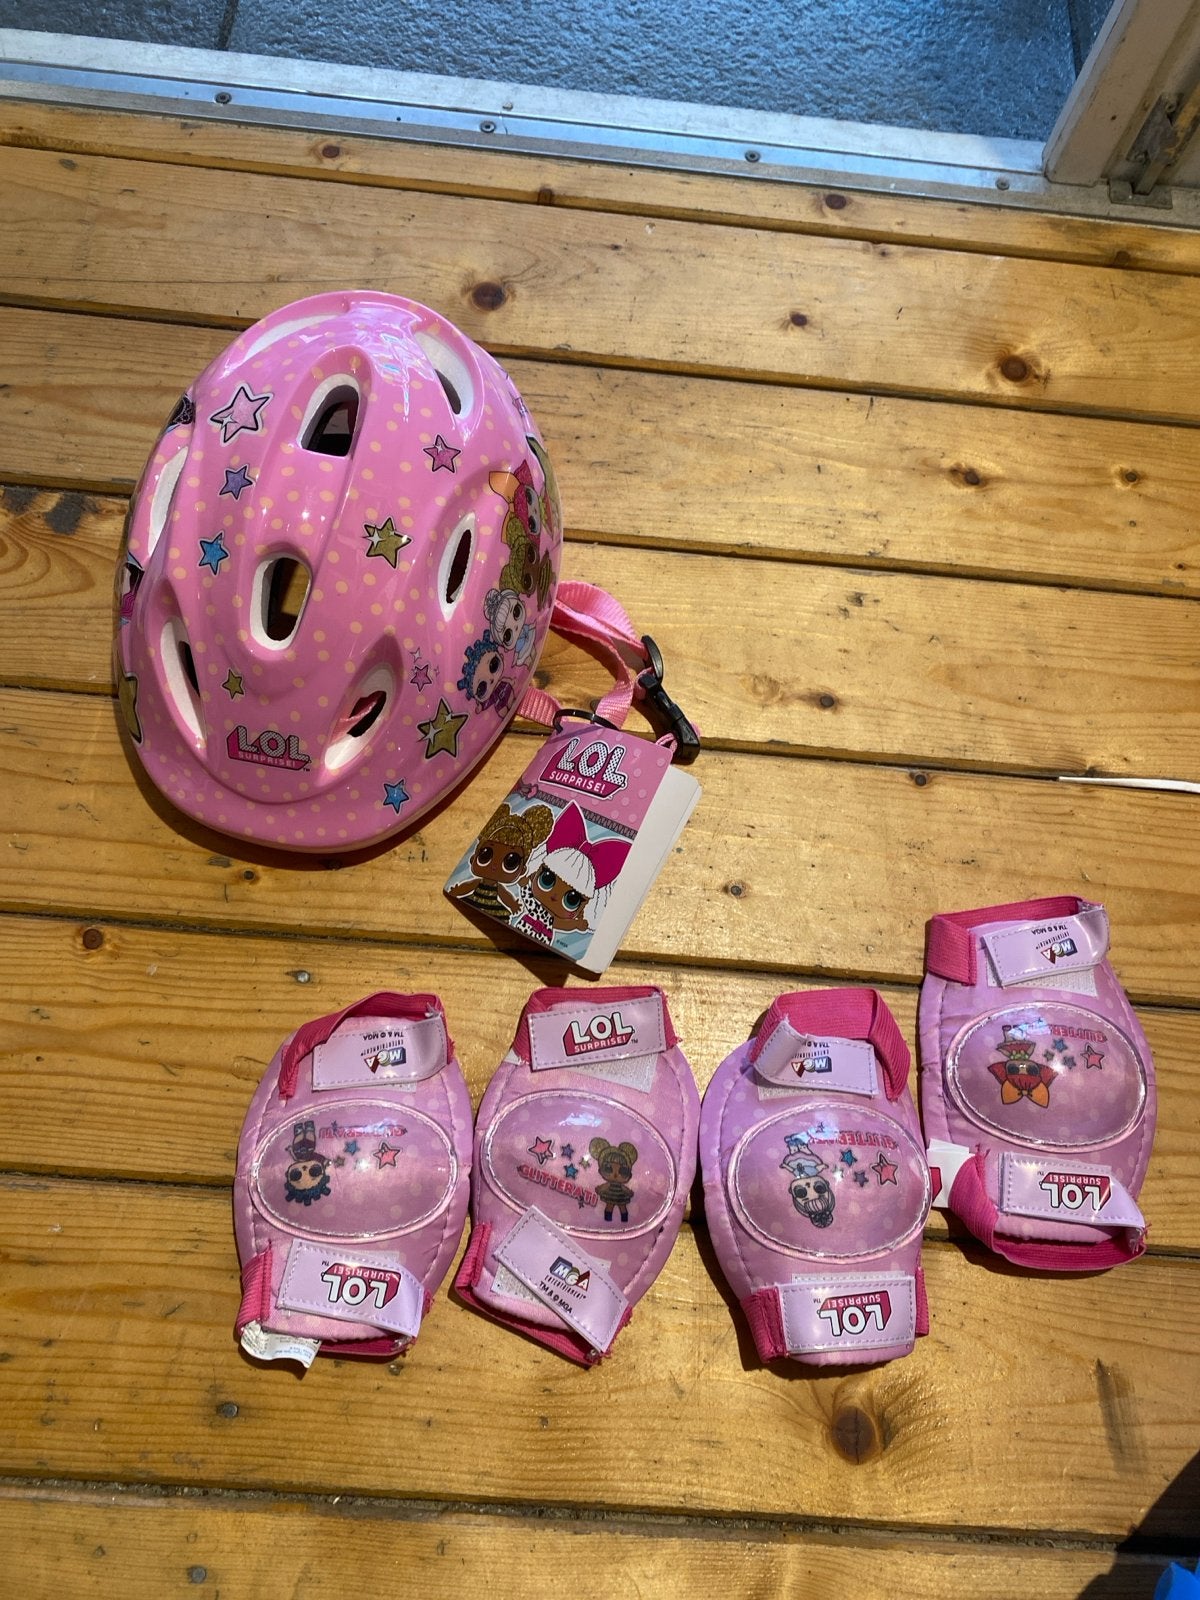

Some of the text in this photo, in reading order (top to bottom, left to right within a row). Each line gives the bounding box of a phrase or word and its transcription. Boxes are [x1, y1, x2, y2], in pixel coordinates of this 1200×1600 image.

[238, 752, 296, 767] SURPRISE!
[549, 771, 606, 793] SURPRISE!
[1042, 939, 1076, 962] MGA
[1032, 1024, 1108, 1043] GLITTER
[573, 1035, 627, 1053] SURPRISE!
[364, 1047, 405, 1070] MGA
[792, 1056, 830, 1075] MGA
[517, 1165, 600, 1207] GLITTERATI
[1048, 1174, 1102, 1186] SURPRISE!
[331, 1265, 392, 1282] SURPRISE!
[552, 1259, 590, 1291] MGA
[827, 1293, 881, 1307] SURPRISE!
